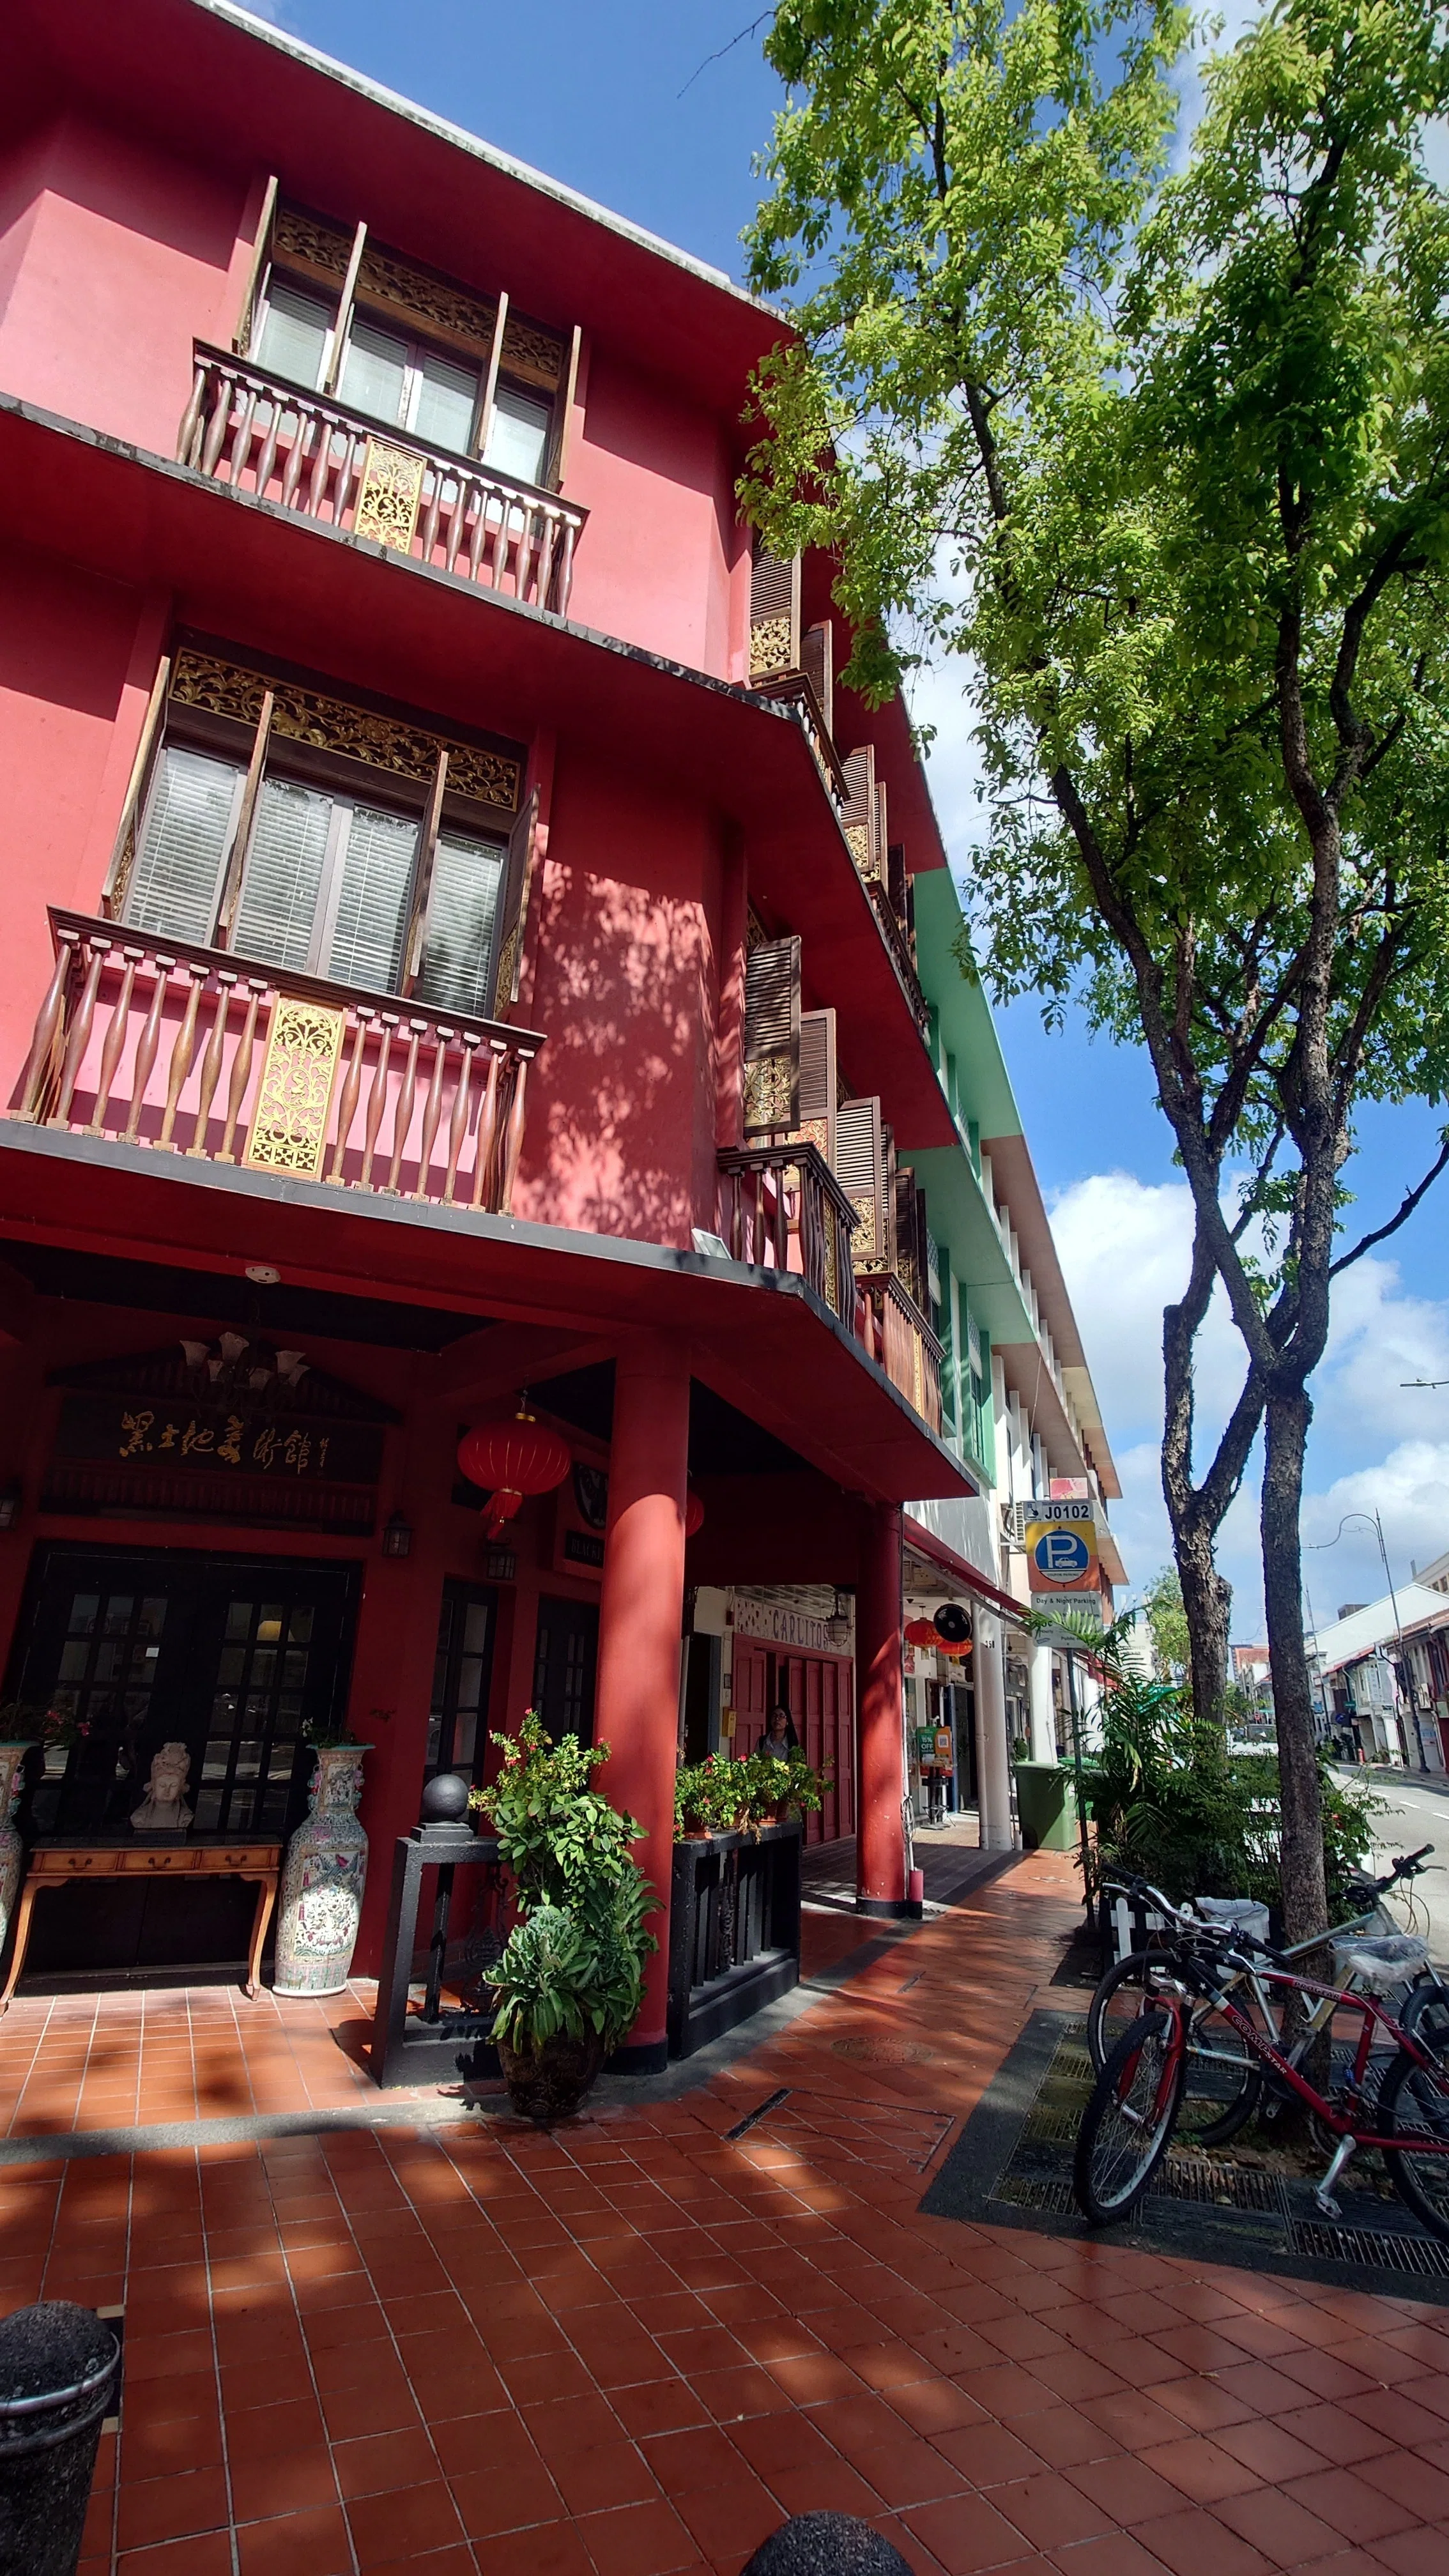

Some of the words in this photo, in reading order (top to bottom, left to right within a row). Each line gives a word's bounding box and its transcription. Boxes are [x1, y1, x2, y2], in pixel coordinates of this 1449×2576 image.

[1045, 1505, 1089, 1519] J0102
[1046, 1536, 1078, 1568] P
[773, 1609, 829, 1651] CARLITOS
[1294, 1981, 1341, 2000] PROGEAR
[1232, 2015, 1287, 2074] COMPSTAR
